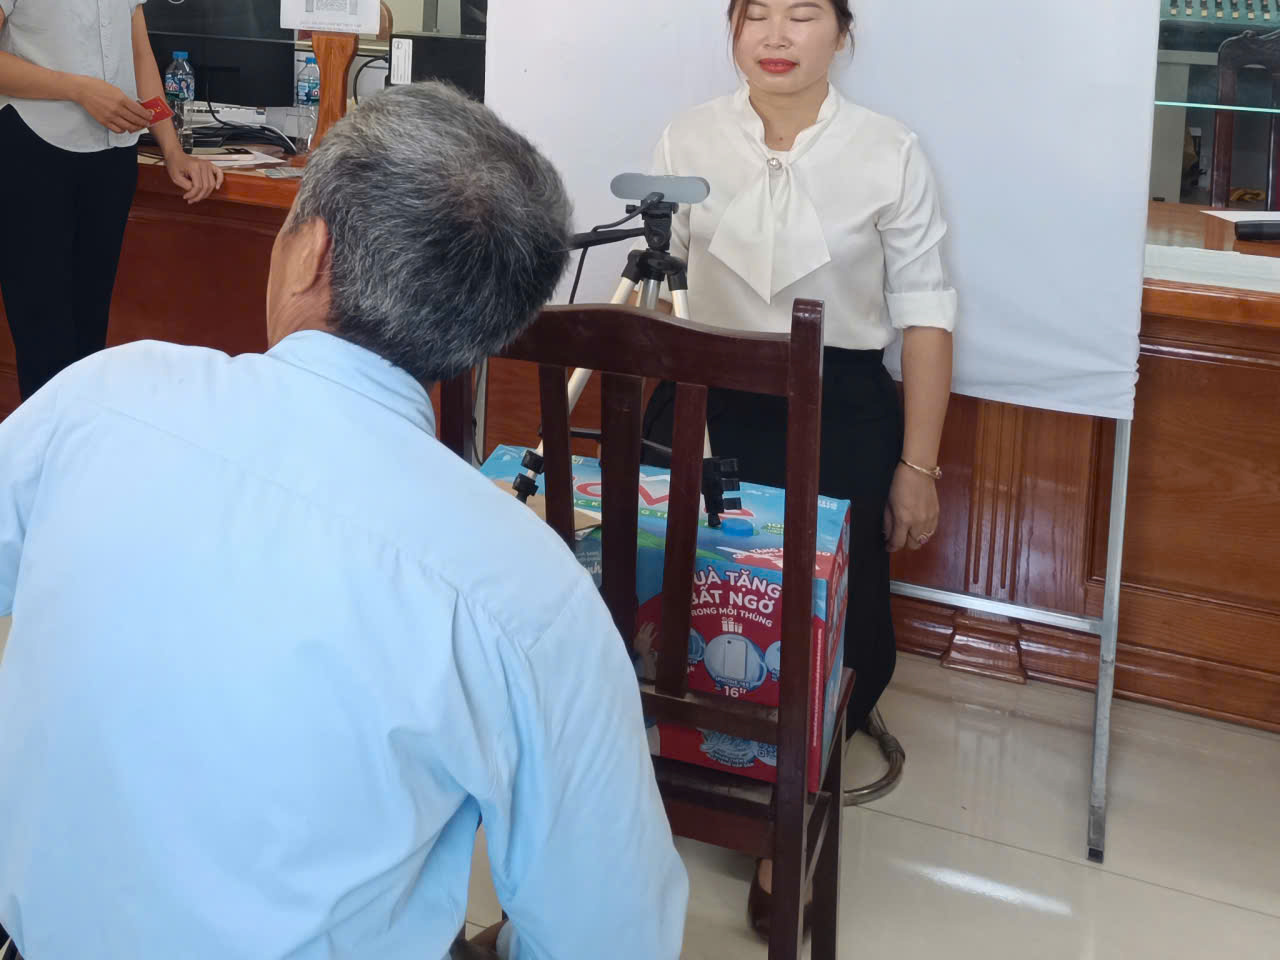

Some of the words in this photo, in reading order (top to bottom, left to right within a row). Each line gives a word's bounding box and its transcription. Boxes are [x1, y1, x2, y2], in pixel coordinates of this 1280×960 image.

[693, 566, 722, 586] UÀ
[725, 569, 782, 599] TẶNG
[729, 591, 775, 614] NGỜ
[690, 607, 717, 617] RONG
[739, 609, 774, 628] THÙNG
